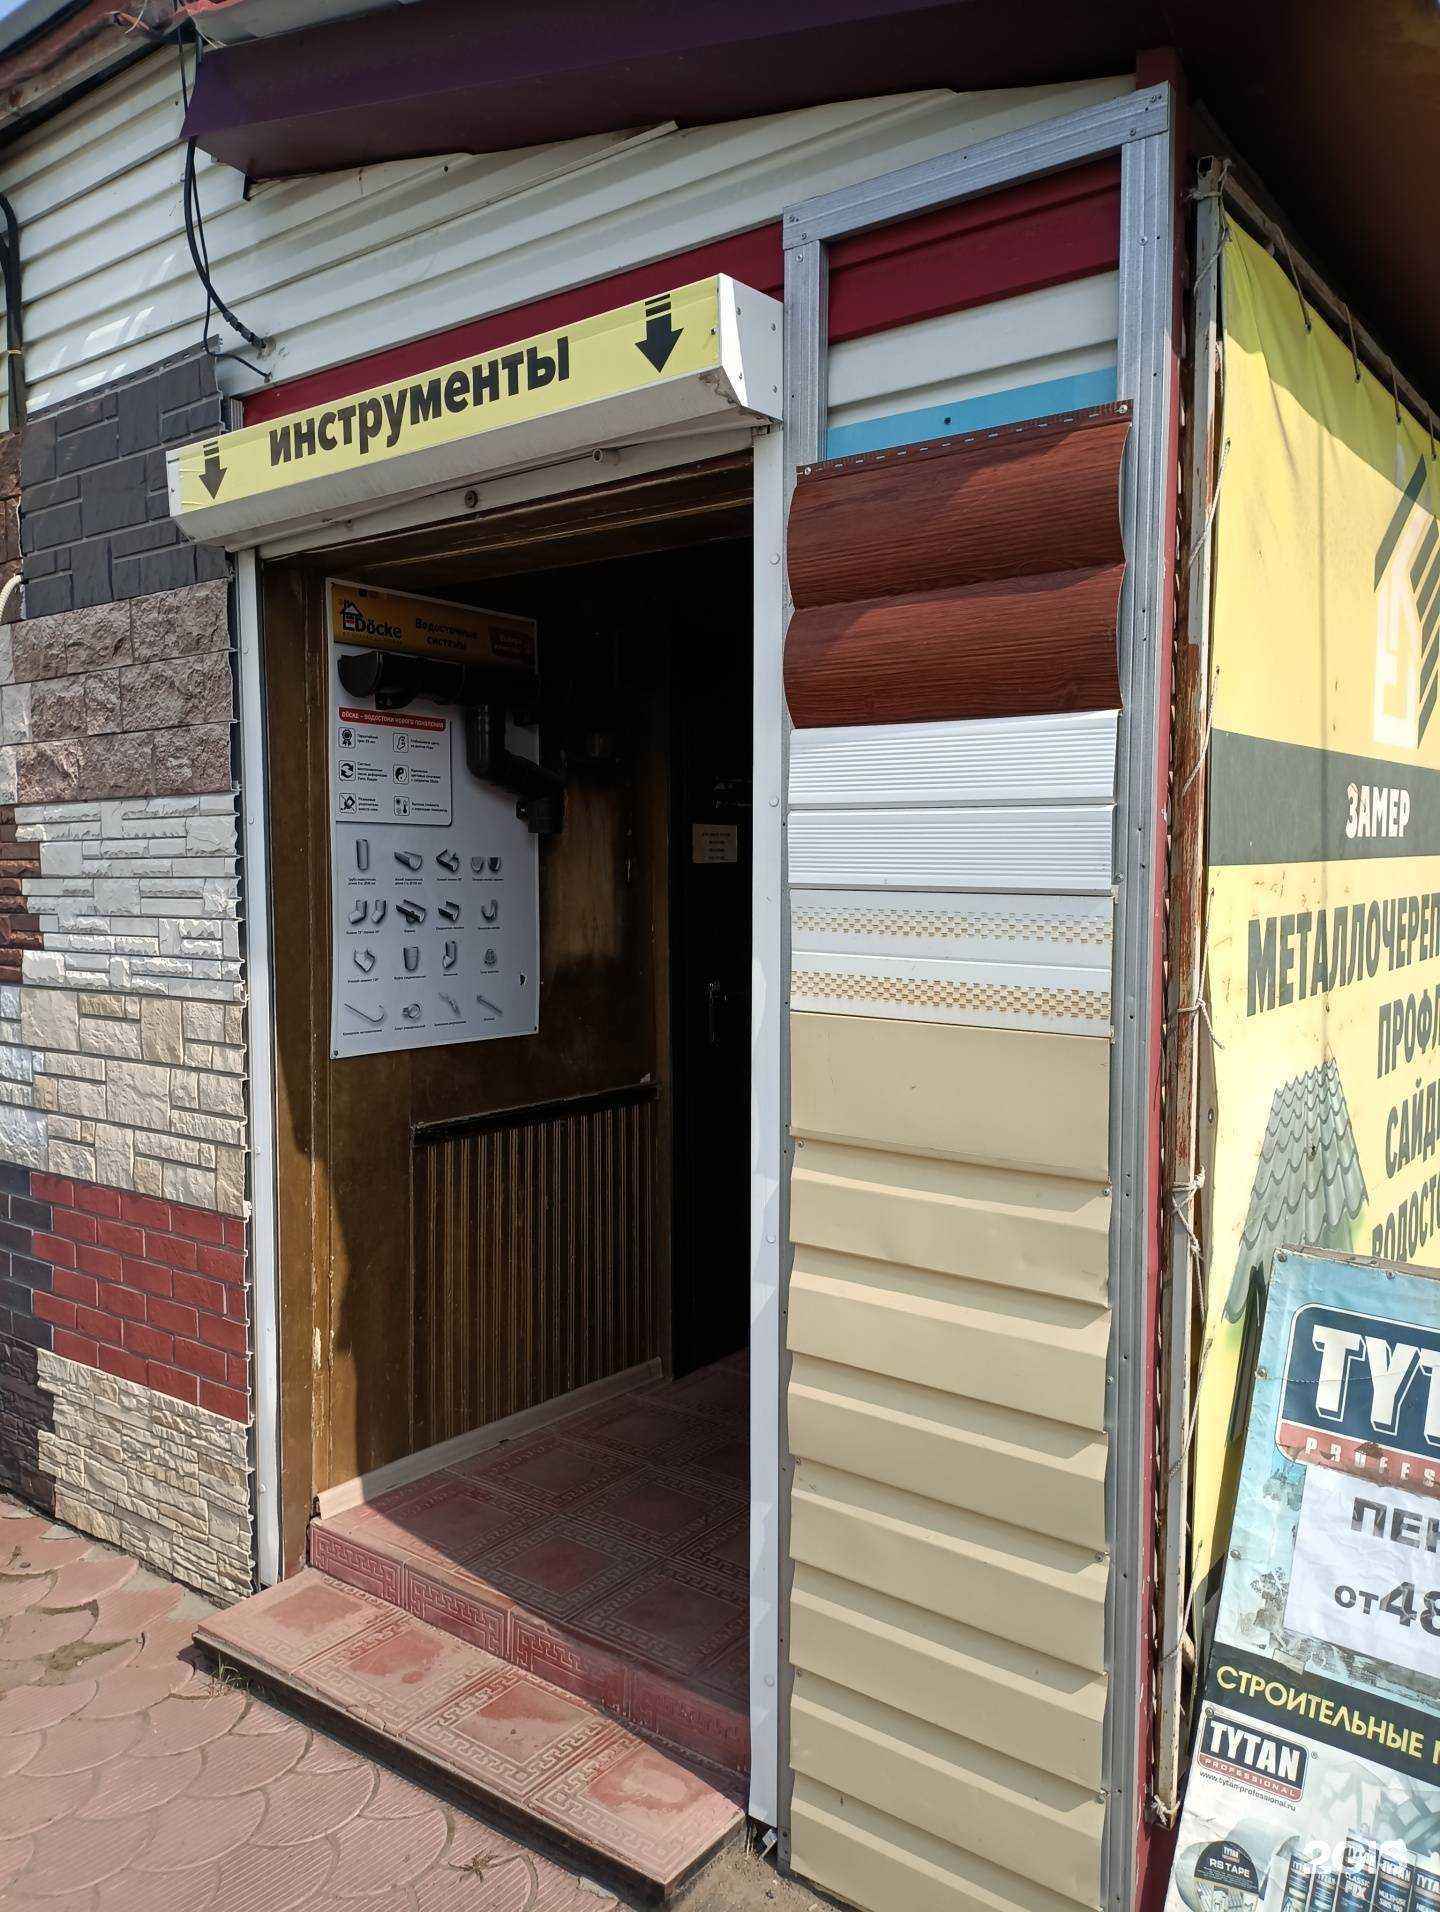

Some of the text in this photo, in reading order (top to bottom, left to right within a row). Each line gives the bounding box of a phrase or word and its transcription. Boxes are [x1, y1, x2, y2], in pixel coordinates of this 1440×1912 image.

[268, 336, 571, 466] инструменты
[1346, 783, 1411, 839] ЗАМЕР
[1247, 892, 1440, 1017] МЕТАЛЛОЧЕРЕП
[1210, 1720, 1301, 1782] TYTAN
[1216, 1665, 1425, 1759] СТРОИТЕЛЬНЫЕ
[1205, 1758, 1296, 1797] PROFESSIONAL
